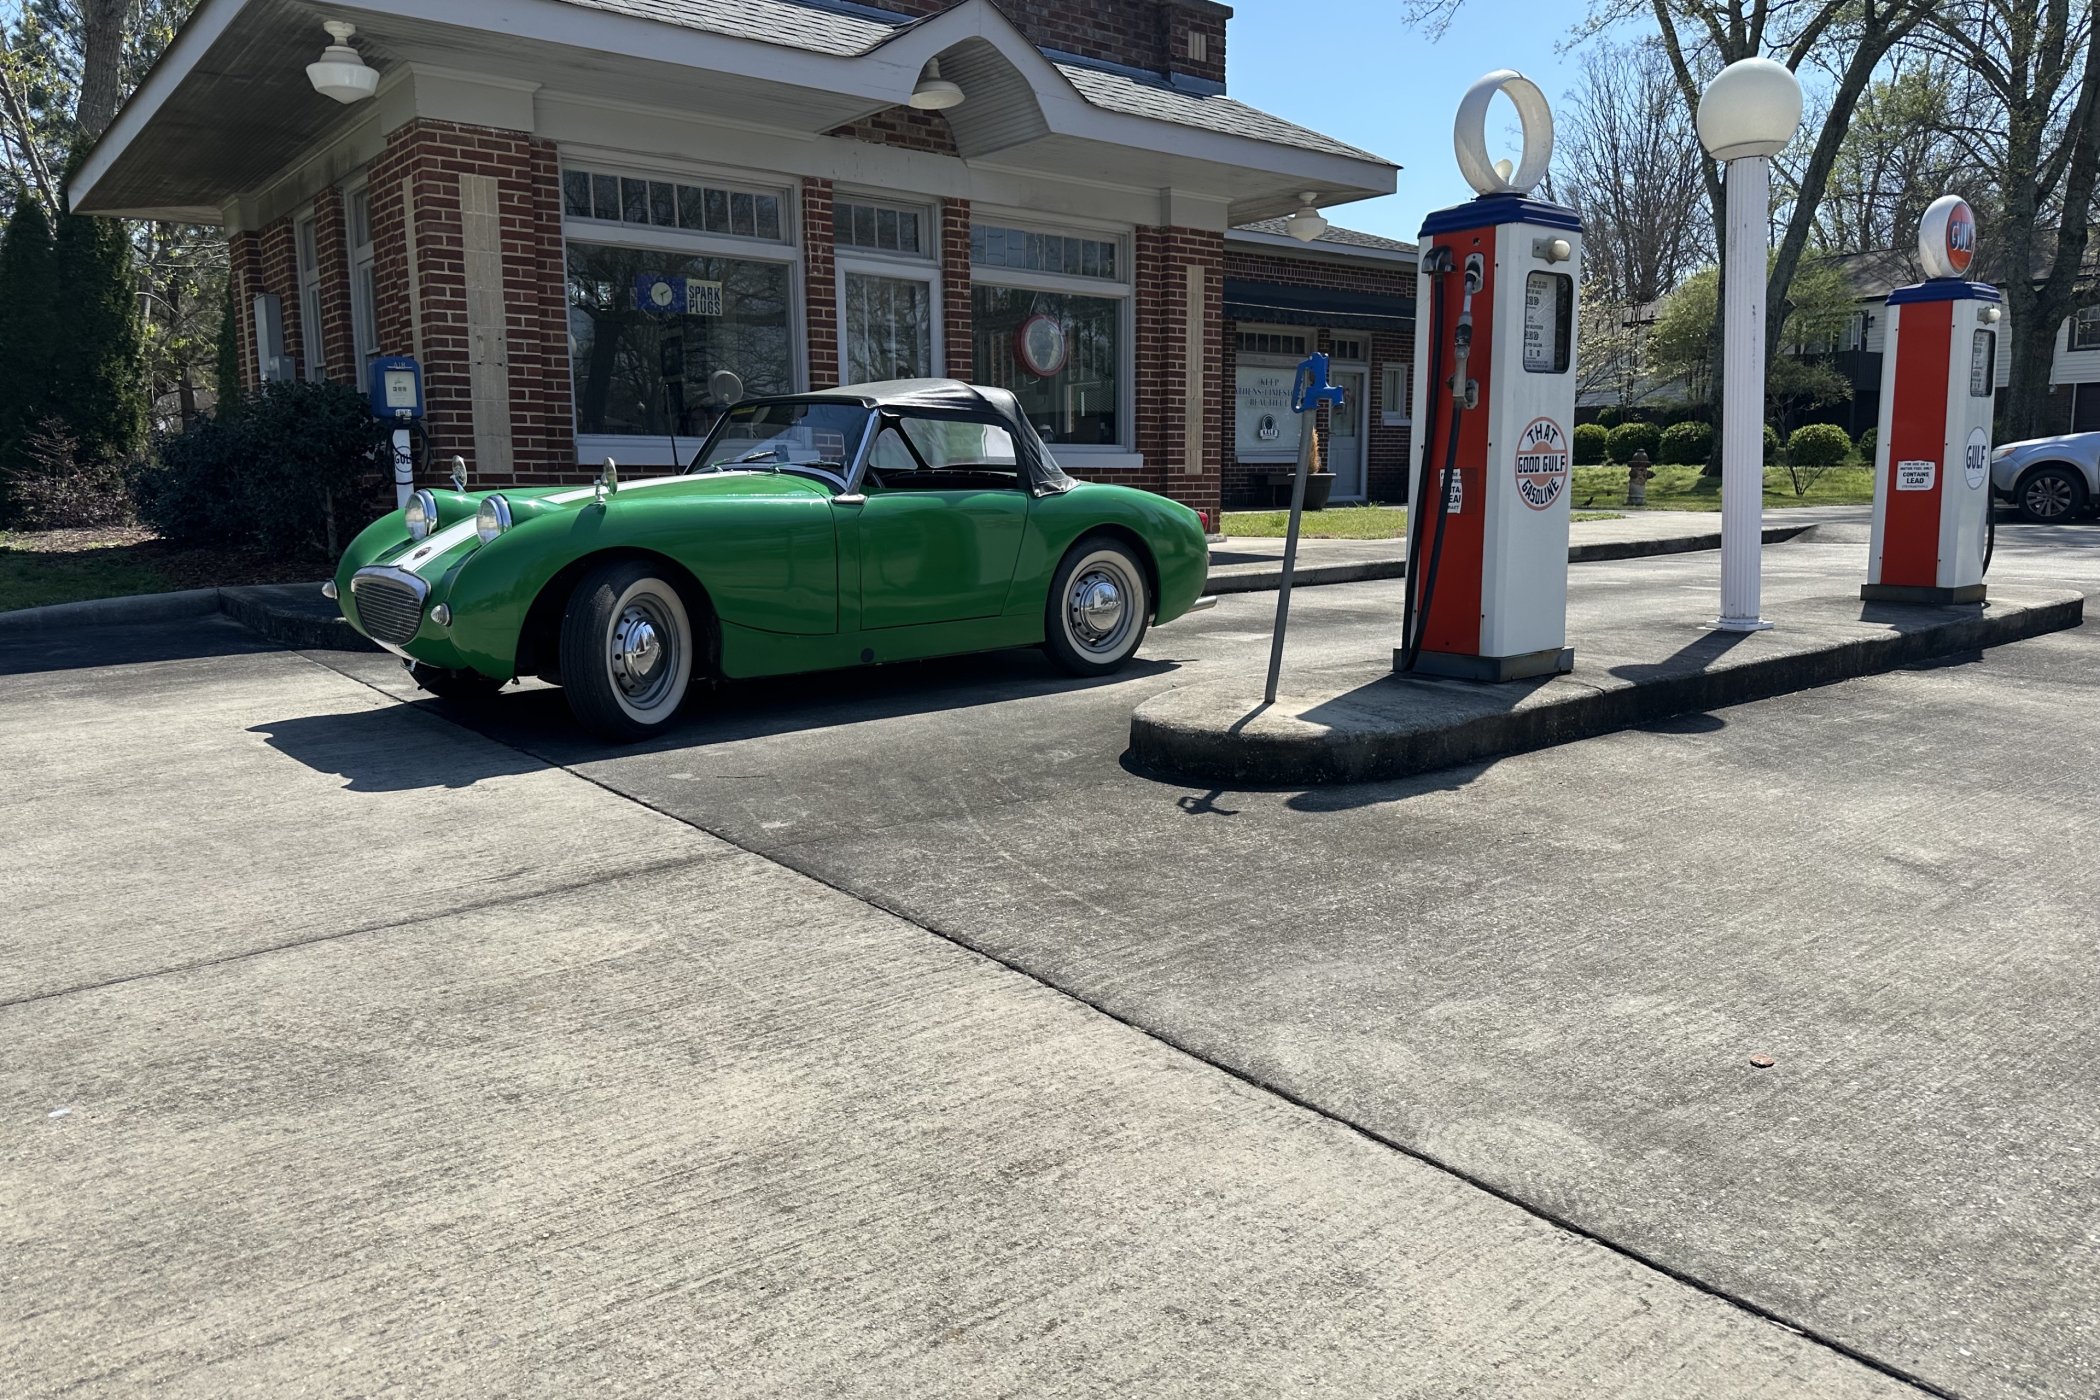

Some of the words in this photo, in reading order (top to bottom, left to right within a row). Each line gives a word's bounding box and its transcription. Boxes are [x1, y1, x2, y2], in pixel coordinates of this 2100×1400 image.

[688, 285, 720, 302] SPARK
[689, 300, 720, 315] PLUGS
[1260, 378, 1279, 386] KEEP
[1249, 398, 1289, 407] BEAUTIFUL
[1527, 424, 1558, 444] THAT
[1518, 456, 1540, 473] GOOD
[1542, 455, 1565, 472] GULF
[1966, 445, 1986, 469] GULF
[1522, 478, 1560, 505] GASOLINE
